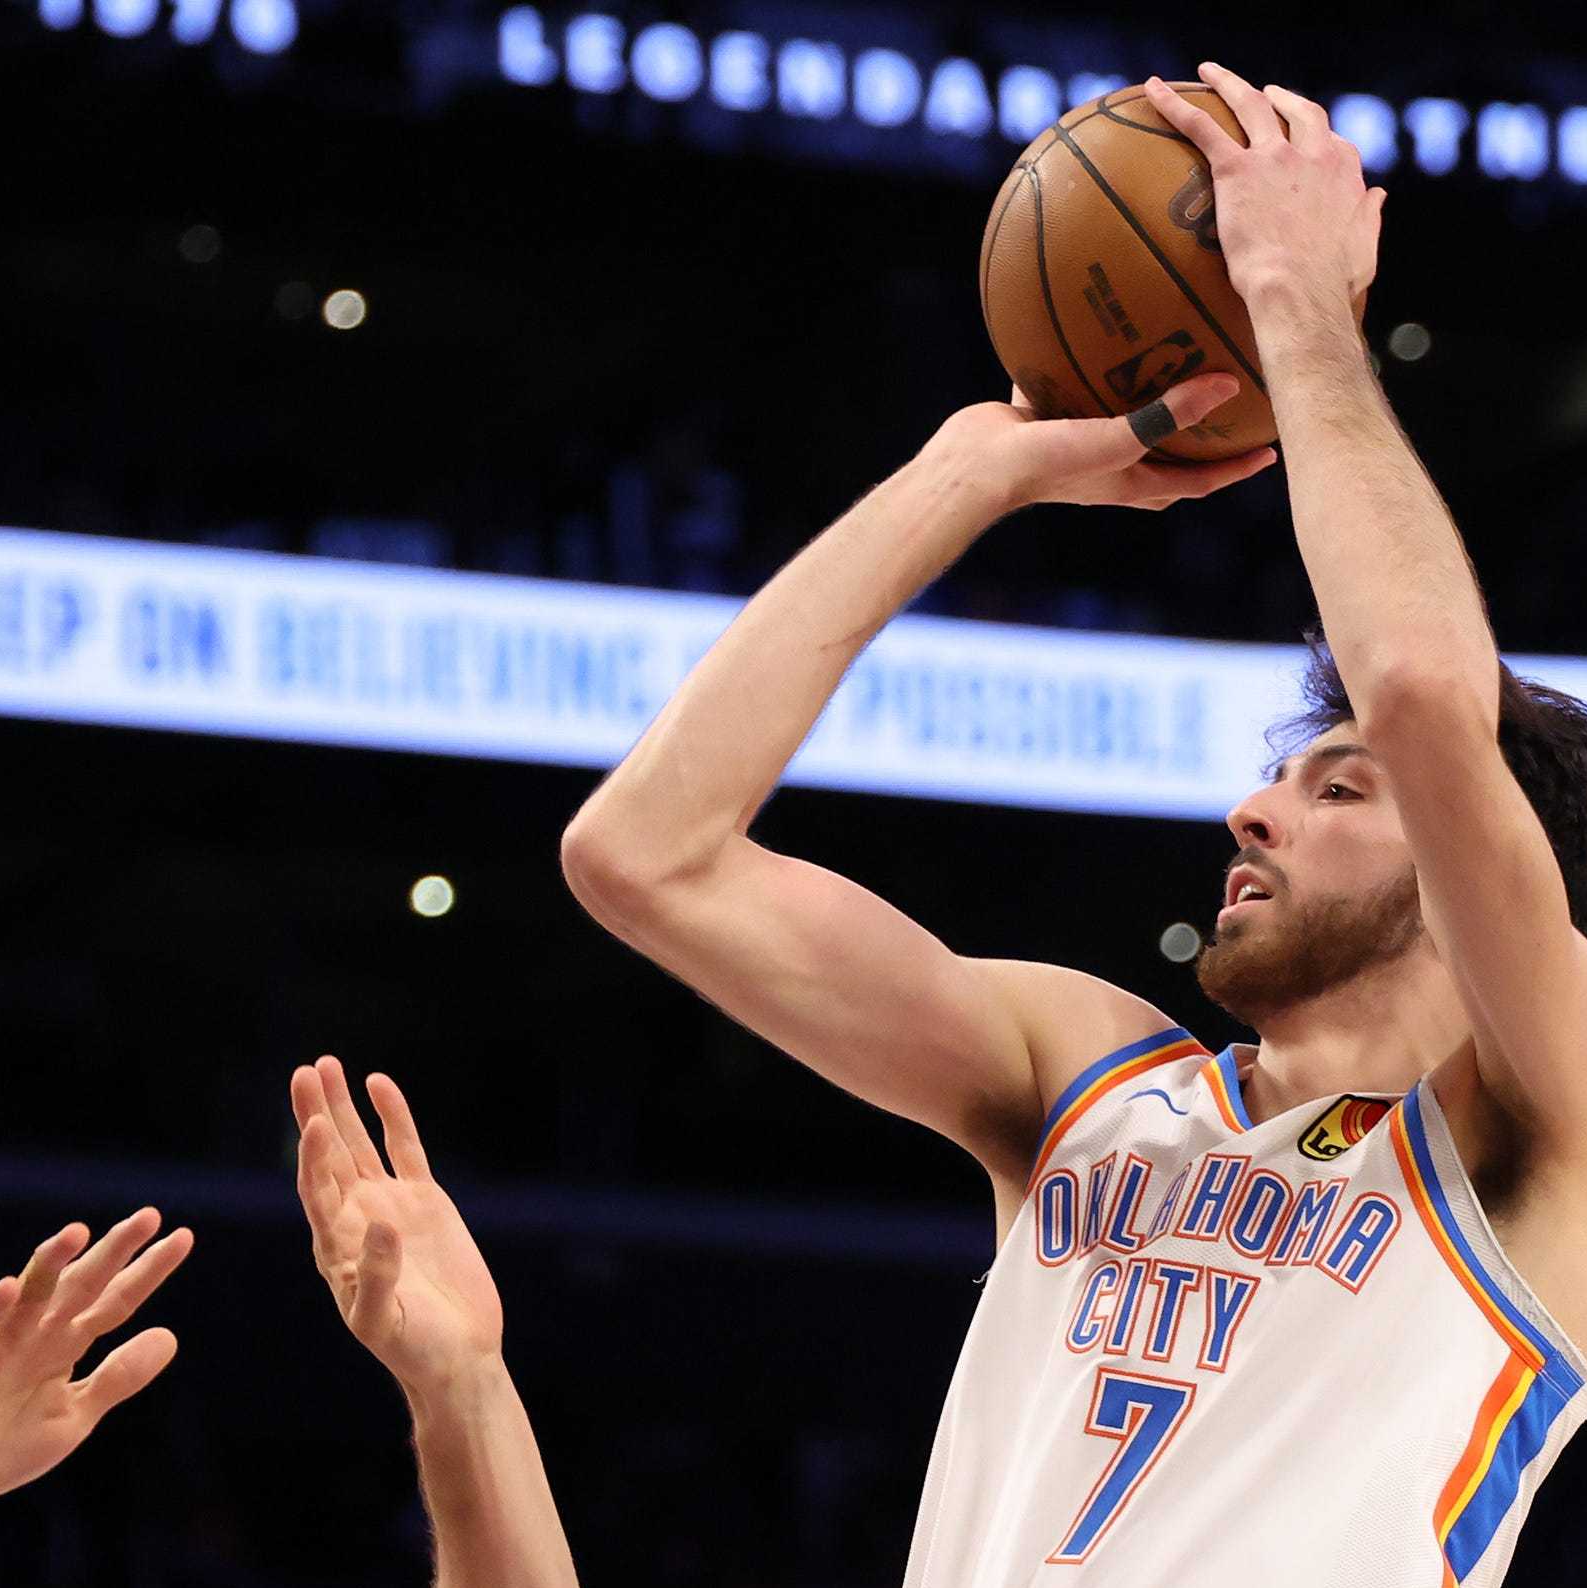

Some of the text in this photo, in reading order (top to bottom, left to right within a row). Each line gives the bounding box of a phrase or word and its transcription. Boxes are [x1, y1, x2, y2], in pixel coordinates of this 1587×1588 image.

[118, 582, 228, 690] ON
[1035, 1152, 1401, 1294] OKLAHOMA
[1066, 1258, 1261, 1373] CITY
[1045, 1367, 1197, 1565] 7
